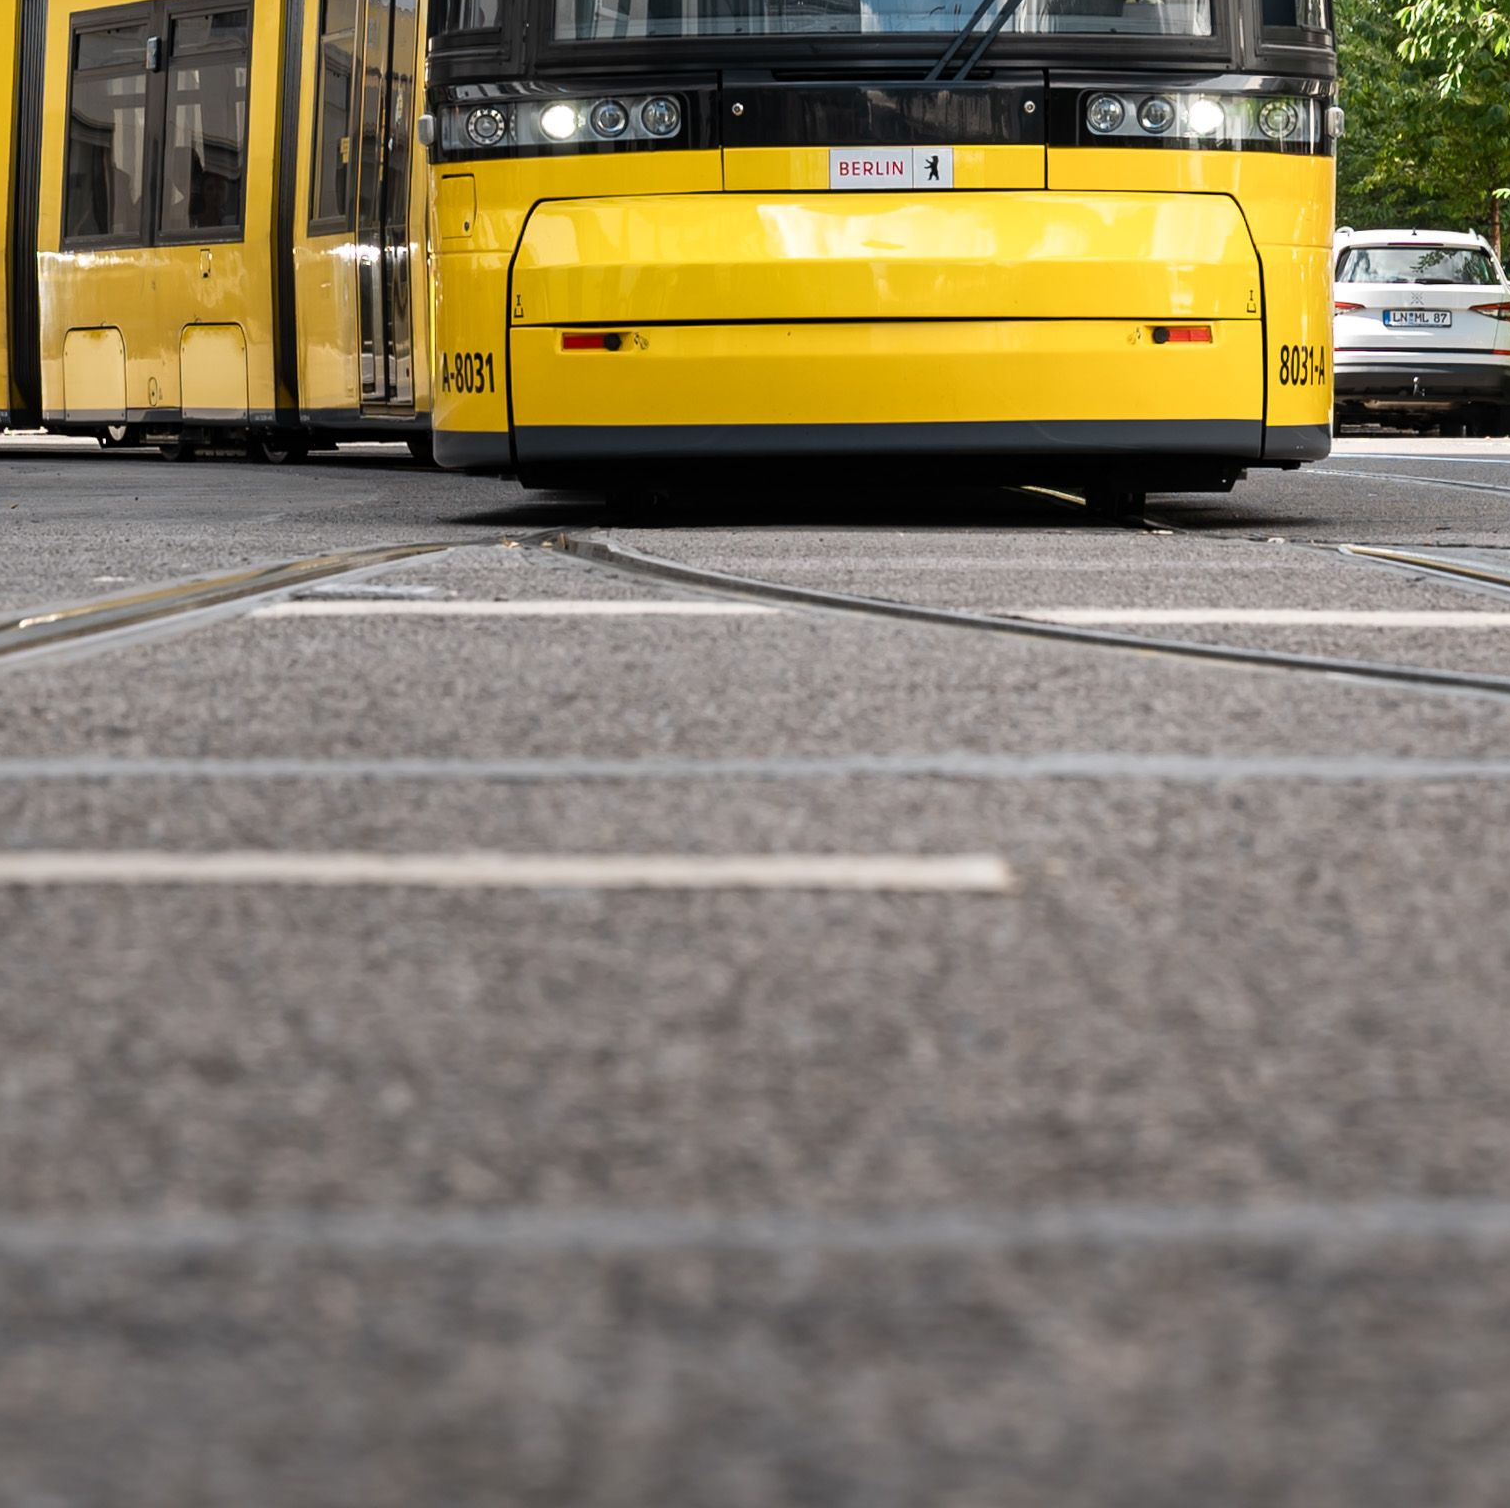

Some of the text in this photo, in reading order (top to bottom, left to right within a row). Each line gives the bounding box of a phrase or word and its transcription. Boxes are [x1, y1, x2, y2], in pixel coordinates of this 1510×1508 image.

[839, 160, 904, 176] BERLIN
[1392, 312, 1448, 324] LN ML 87
[442, 352, 496, 394] A-8031
[1279, 344, 1326, 387] 8031-A
